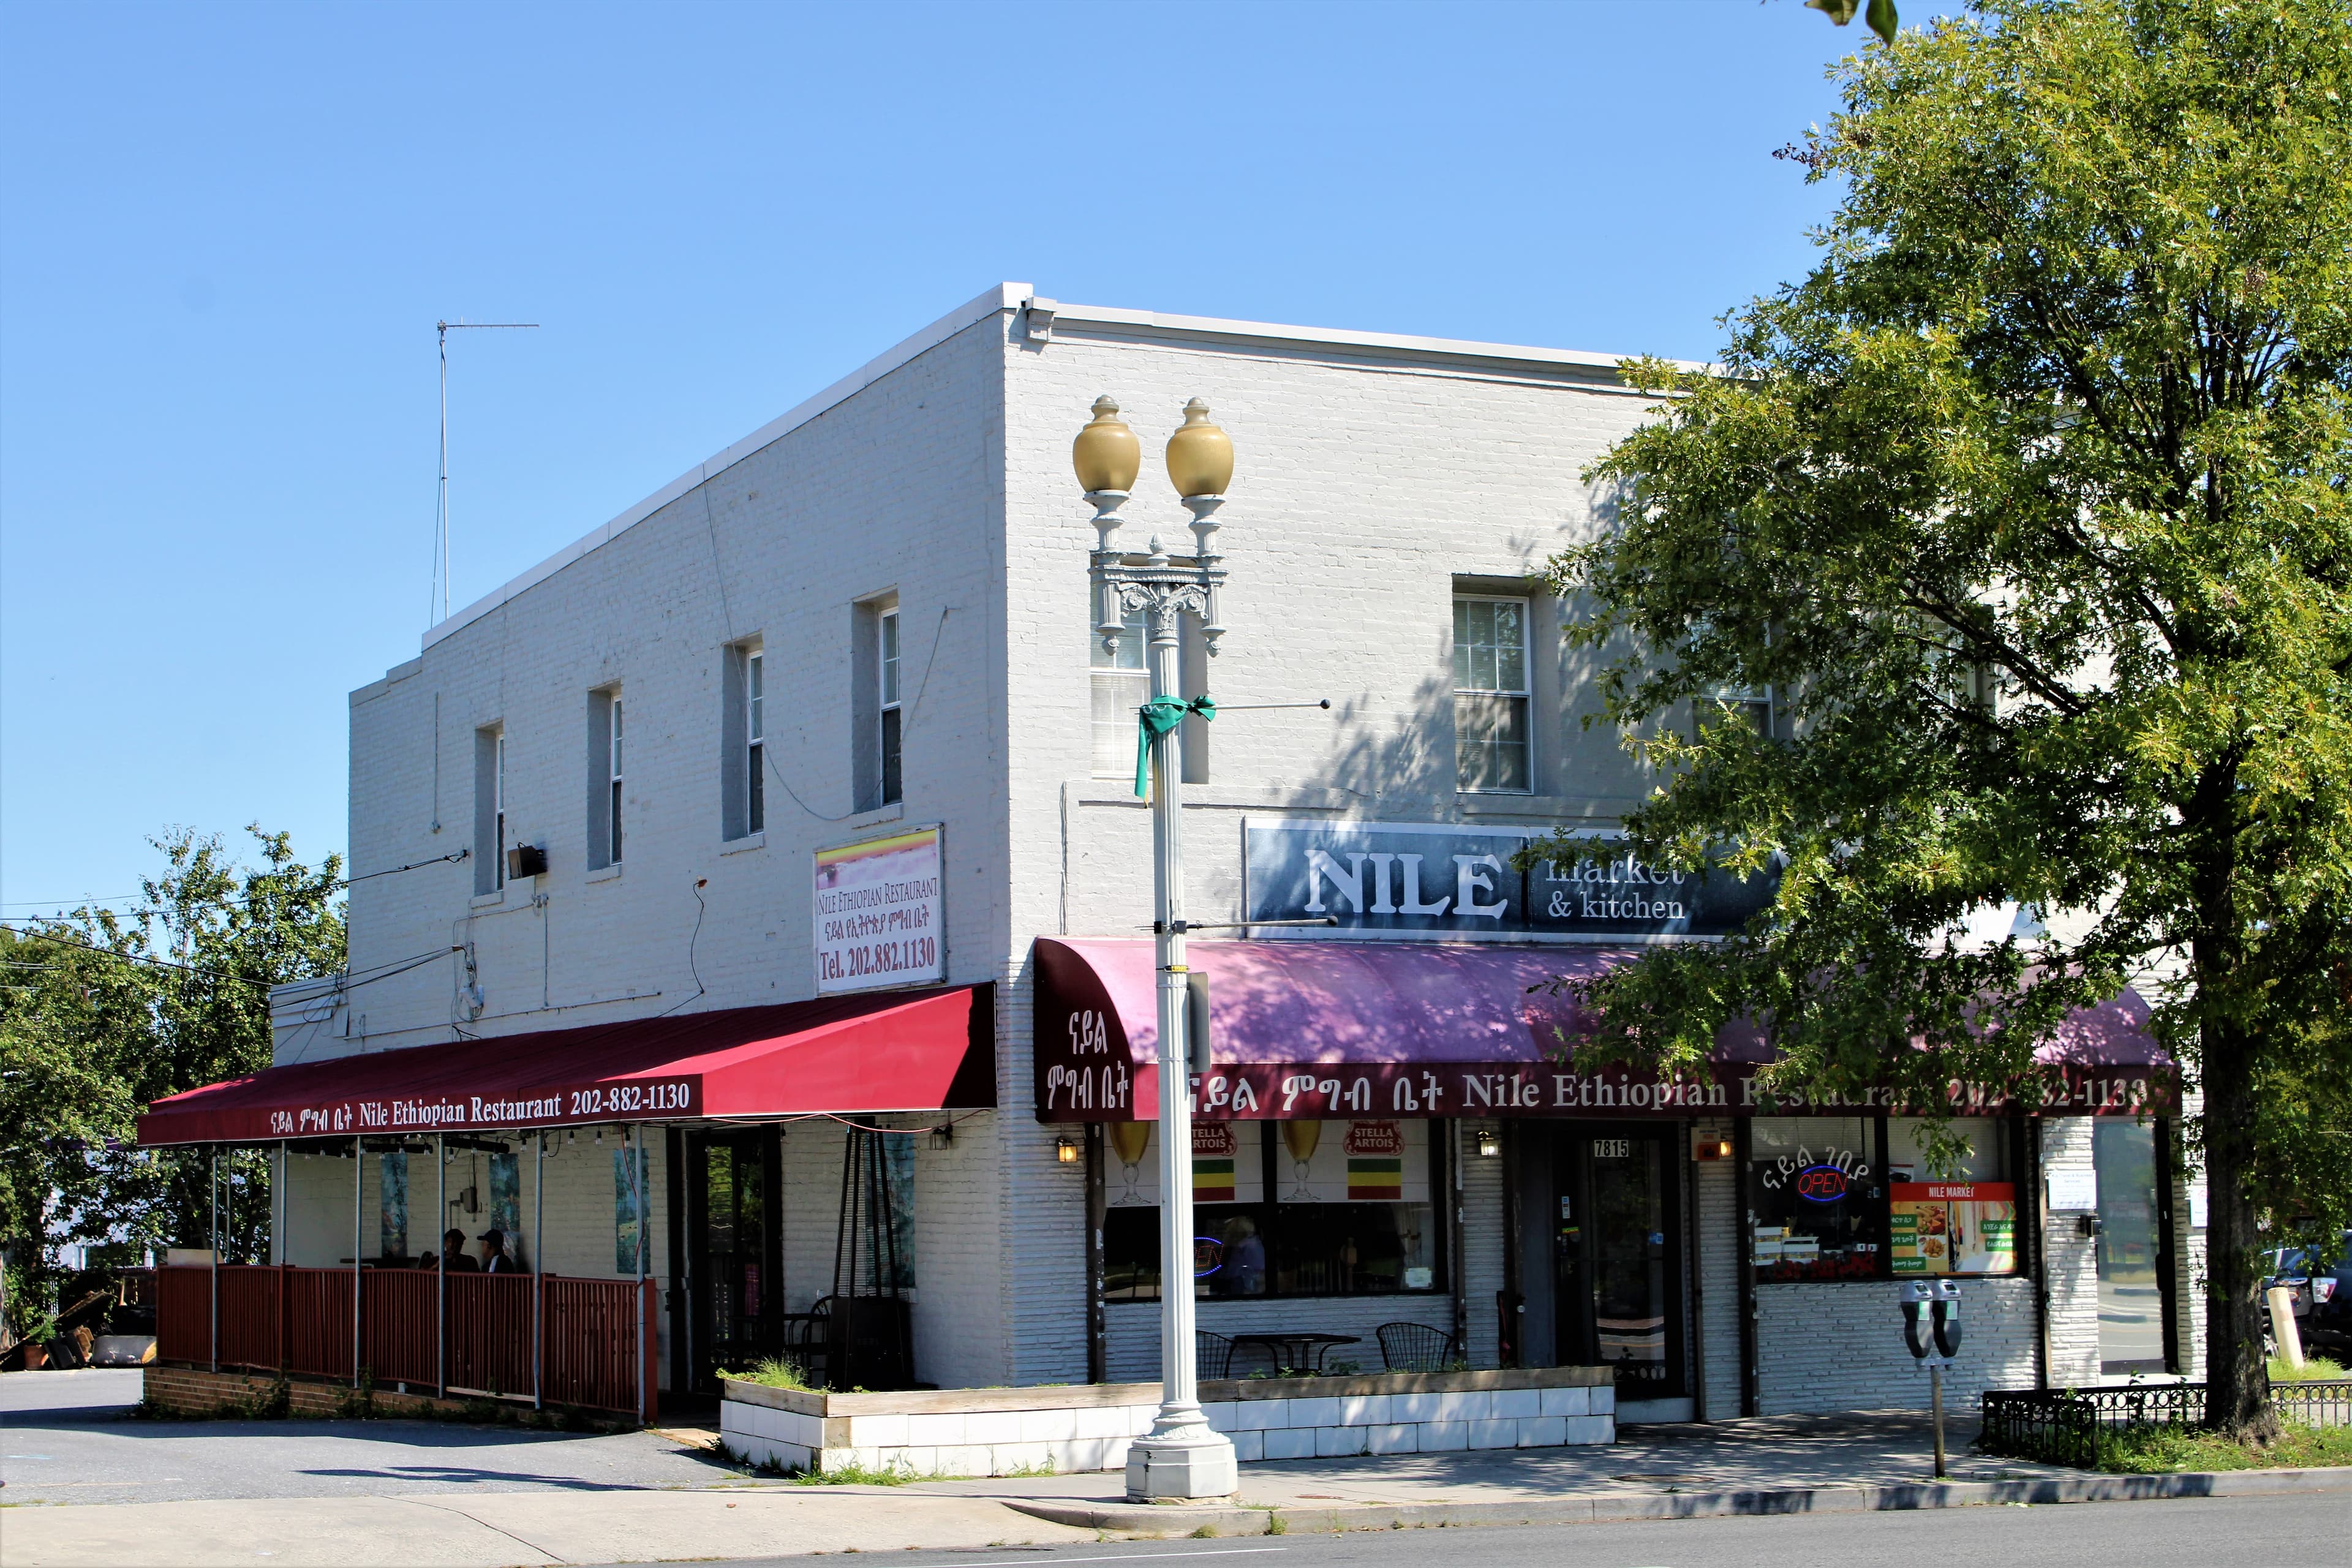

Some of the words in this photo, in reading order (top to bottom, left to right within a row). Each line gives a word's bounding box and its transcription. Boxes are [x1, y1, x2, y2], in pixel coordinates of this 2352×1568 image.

[1303, 850, 1509, 919] NILE
[1548, 890, 1572, 918] &
[1580, 891, 1685, 919] kitchen
[825, 920, 844, 942] ናይል
[914, 903, 929, 927] ቤት
[820, 950, 845, 980] Tel.
[848, 937, 935, 977] 202.882.1130
[1069, 1010, 1108, 1055] ናይል
[1047, 1065, 1092, 1109] ምግብ
[1102, 1060, 1128, 1109] ቤት
[1282, 1075, 1370, 1111] ምግብ
[1393, 1071, 1442, 1111] ቤት
[1462, 1074, 1540, 1107] Nile
[1552, 1074, 1728, 1110] Ethiopian
[1948, 1078, 2147, 1107] 202-82-1130
[271, 1110, 293, 1134] ናይል
[300, 1107, 328, 1132] ምግብ
[334, 1103, 352, 1131] ቤት
[359, 1102, 388, 1126] Nile
[392, 1097, 465, 1126] Ethiopian
[470, 1093, 561, 1122] Restaurant
[570, 1083, 690, 1115] 202-882-1130
[1191, 1128, 1226, 1137] TELLA
[1192, 1138, 1226, 1148] RTOIS
[1354, 1128, 1393, 1137] STELLA
[1354, 1137, 1394, 1148] ARTOIS
[1595, 1140, 1629, 1157] 7815
[1798, 1172, 1849, 1194] OPEN
[1929, 1187, 1944, 1197] NILE
[1947, 1186, 1975, 1197] MARKET
